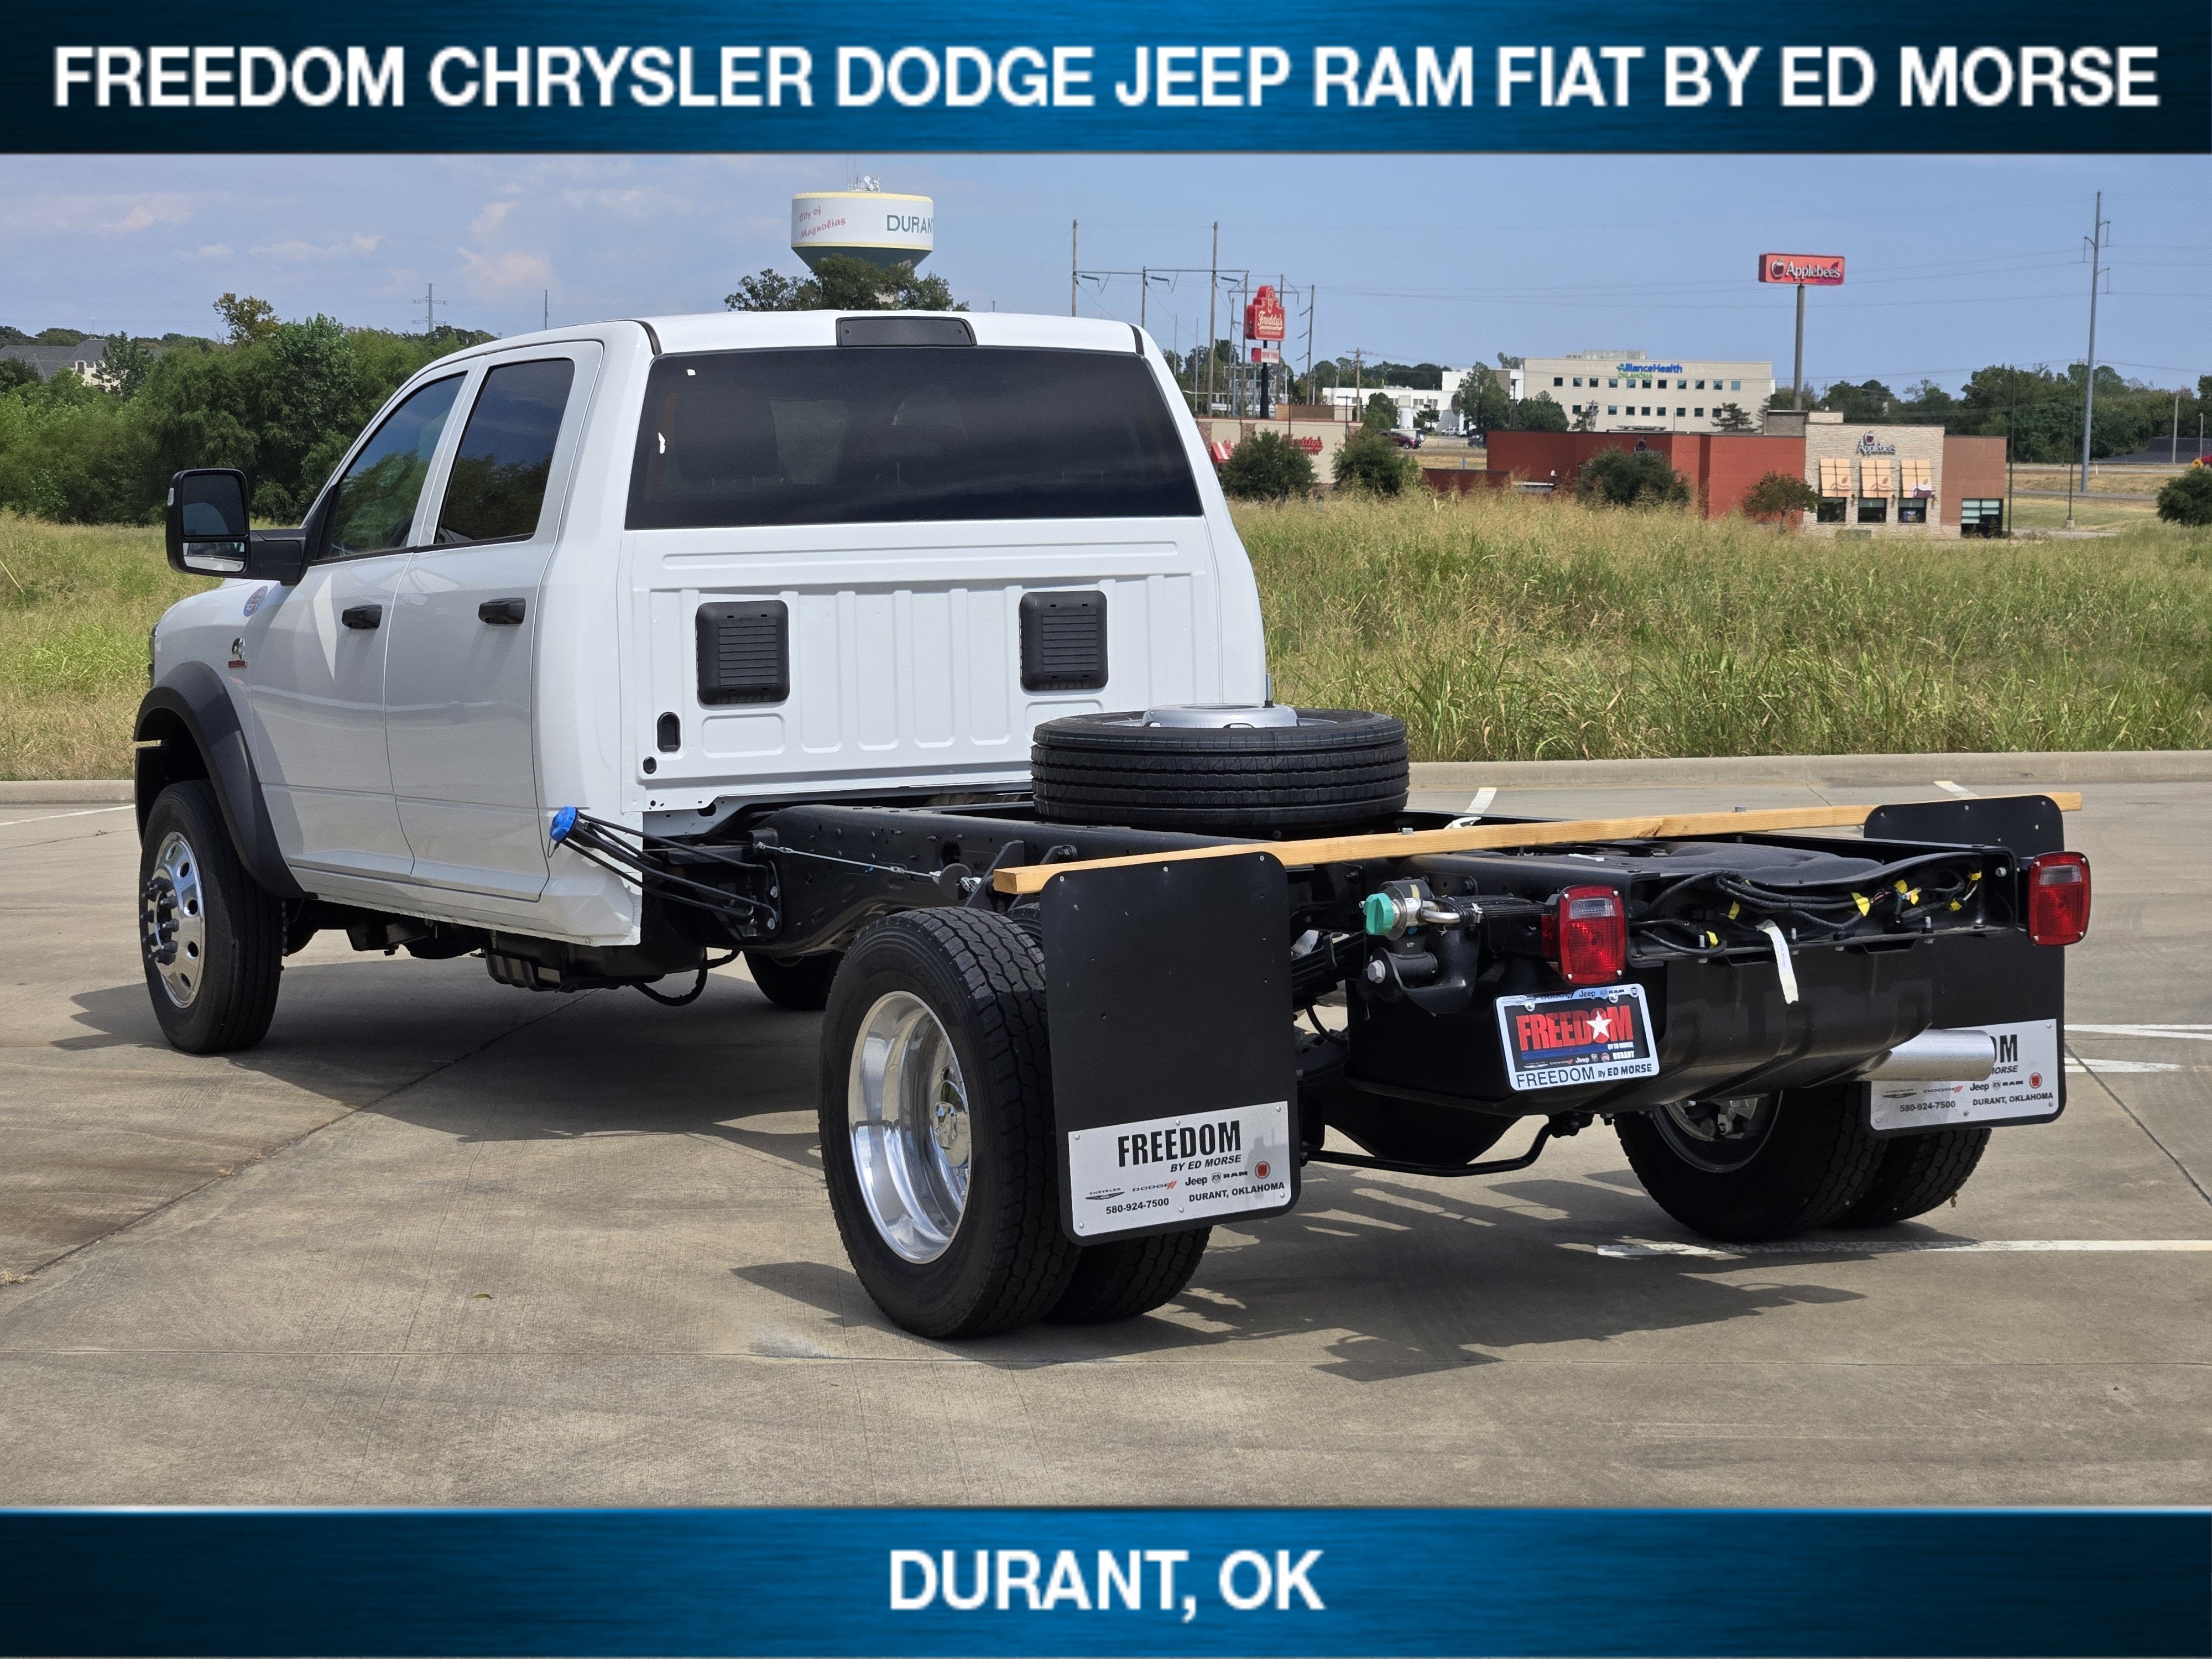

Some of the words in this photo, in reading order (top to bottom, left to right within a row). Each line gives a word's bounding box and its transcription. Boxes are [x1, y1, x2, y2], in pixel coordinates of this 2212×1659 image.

[799, 211, 811, 222] City
[813, 205, 822, 216] of
[800, 217, 846, 240] Magnolias
[1786, 261, 1841, 279] Applebee's
[1258, 311, 1283, 330] Freddy's
[1616, 363, 1683, 373] AllianceHealth
[1516, 1005, 1634, 1051] FREEDOM
[1516, 1066, 1595, 1088] FREEDOM
[1608, 1067, 1619, 1077] ED
[1621, 1063, 1652, 1075] MORSE
[1970, 1082, 1990, 1092] Jeep
[1899, 1100, 1956, 1112] 580-924-7500
[1973, 1096, 2007, 1106] DURANT,
[2008, 1092, 2053, 1103] OKLAHOMA
[1117, 1120, 1241, 1168] FREEDOM
[1170, 1163, 1185, 1173] BY
[1188, 1161, 1202, 1170] ED
[1204, 1154, 1242, 1168] MORSE
[1185, 1176, 1208, 1187] Jeep
[1223, 1170, 1248, 1179] RAM
[1105, 1197, 1170, 1214] 580-924-7500
[1188, 1189, 1229, 1202] DURANT,
[1231, 1181, 1285, 1196] OKLAHOMA
